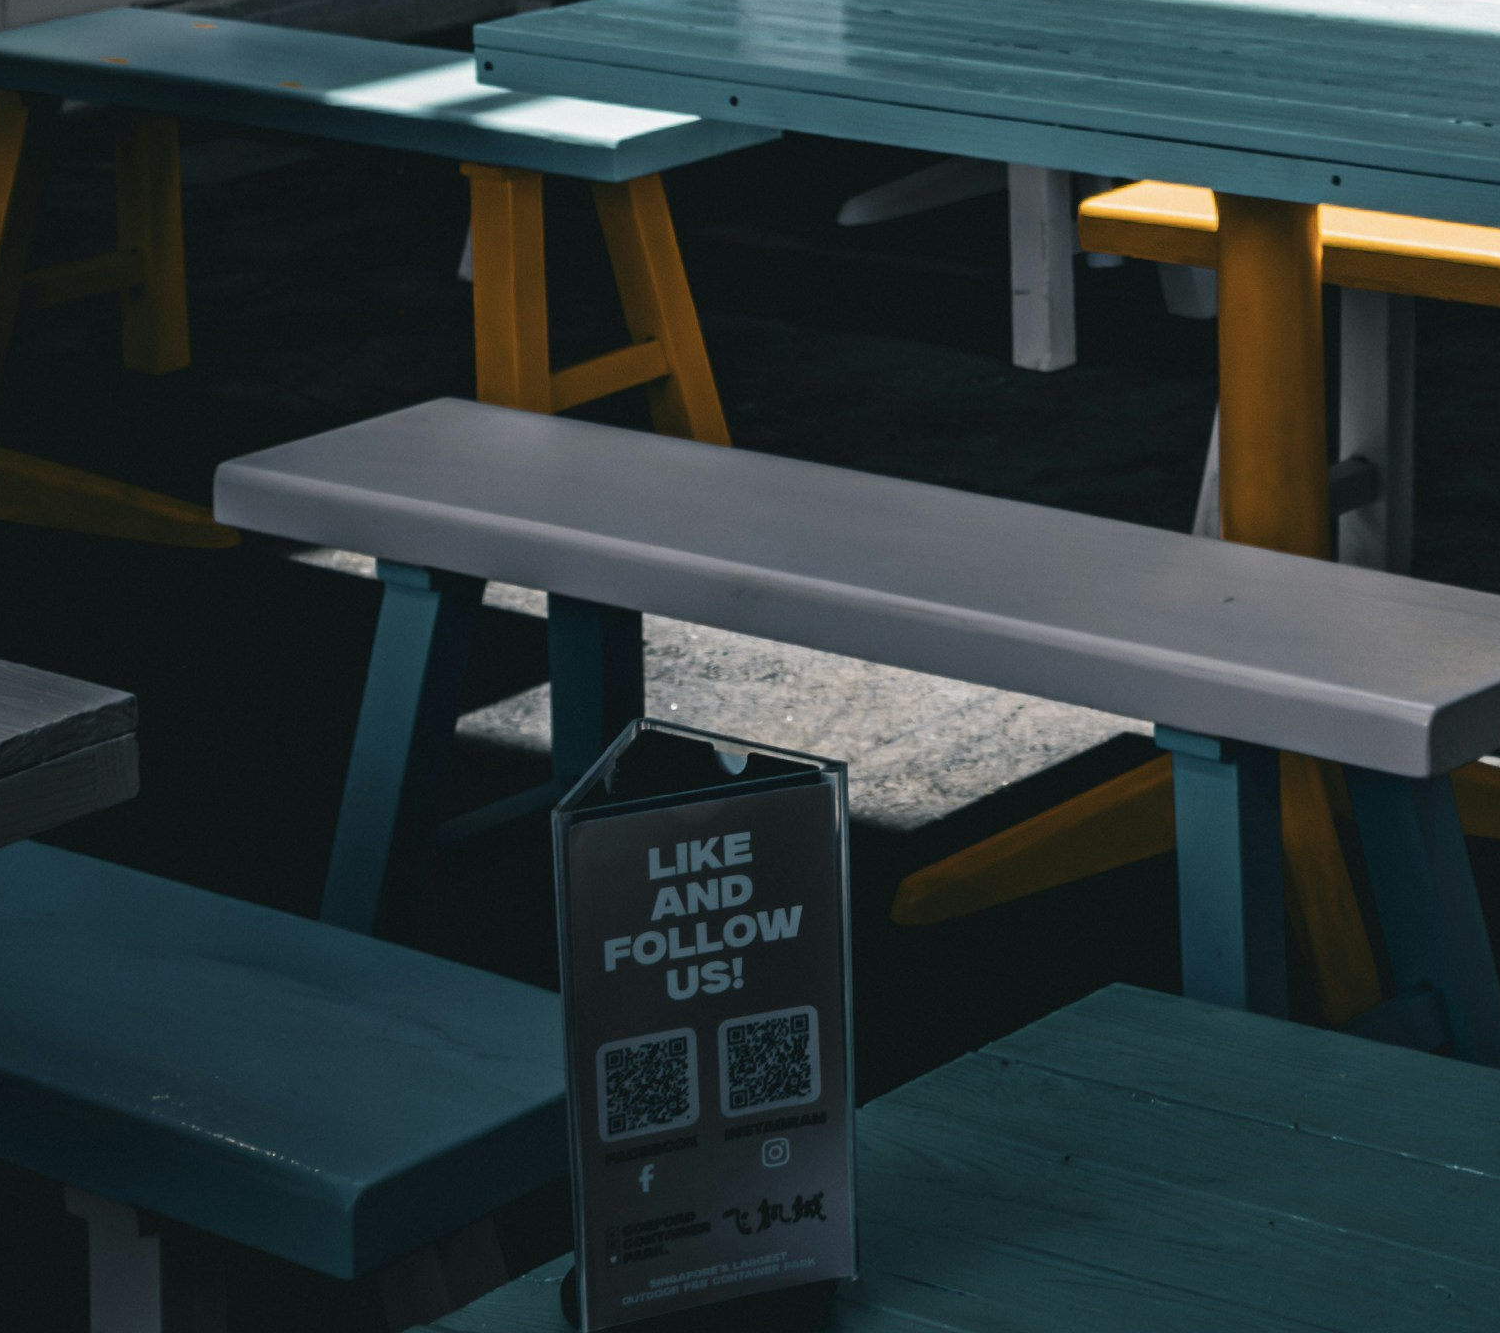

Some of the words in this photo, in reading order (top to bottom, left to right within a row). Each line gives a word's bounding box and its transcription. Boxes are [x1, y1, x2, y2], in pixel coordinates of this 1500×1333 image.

[648, 831, 753, 881] LIKE
[651, 874, 754, 921] AND
[603, 904, 804, 972] FOLLOW
[666, 958, 745, 1001] US!
[724, 1111, 828, 1141] INSTAGRAM
[648, 1263, 730, 1290] SINGAPORE'S
[732, 1251, 788, 1272] LARGEST
[620, 1285, 681, 1306] OUTDOOR
